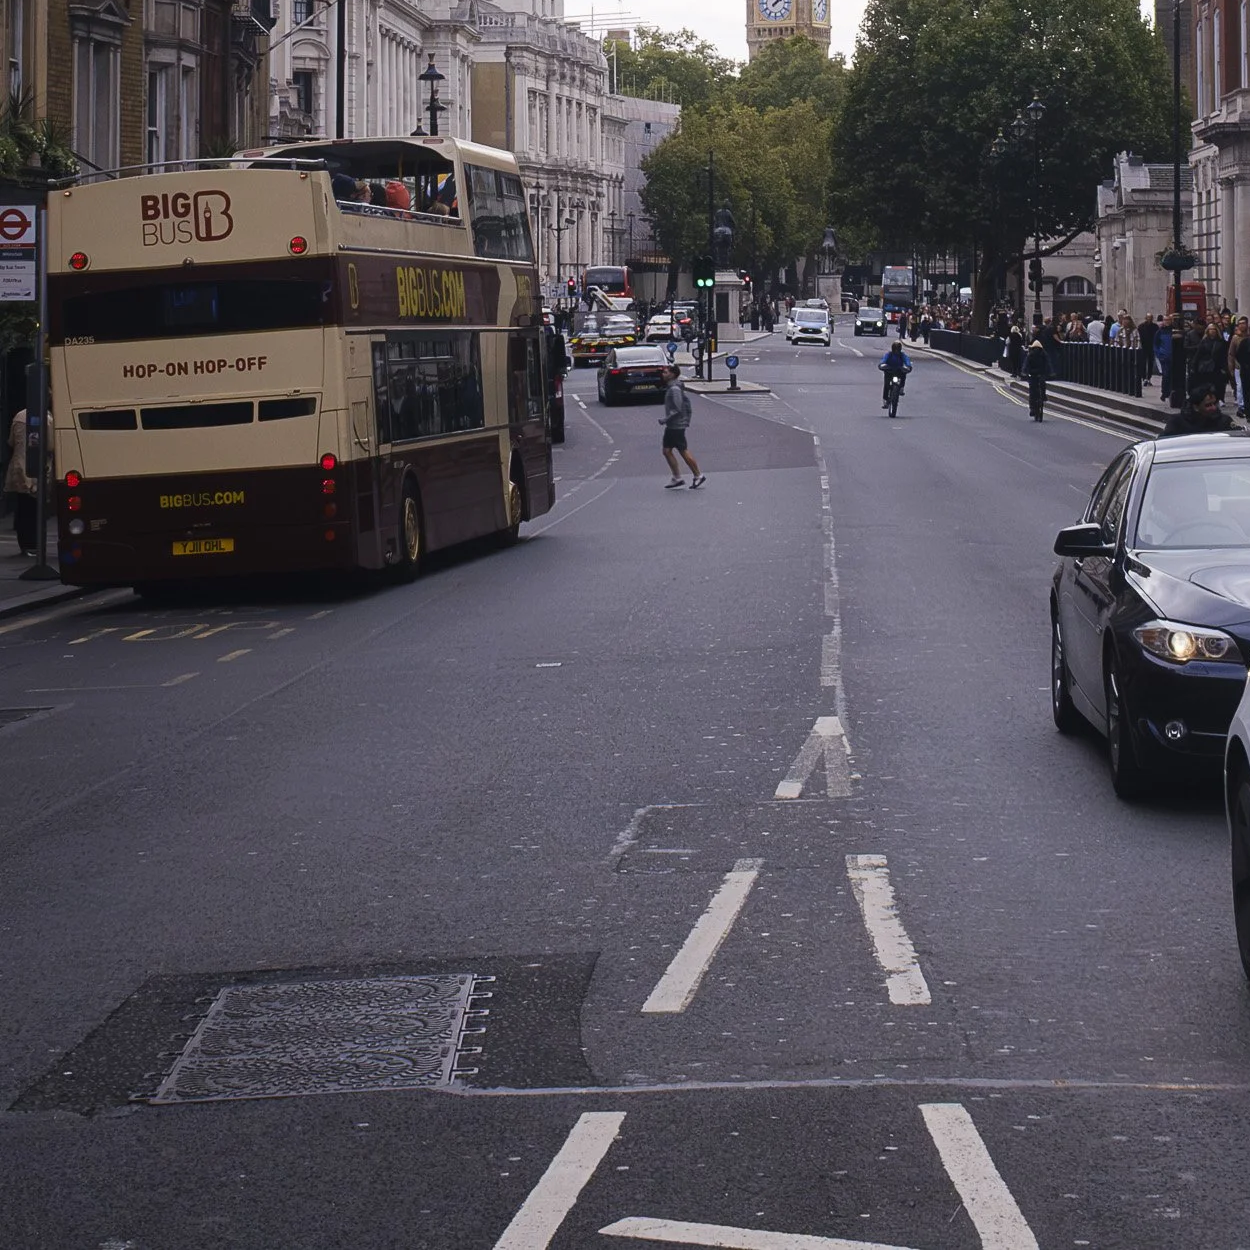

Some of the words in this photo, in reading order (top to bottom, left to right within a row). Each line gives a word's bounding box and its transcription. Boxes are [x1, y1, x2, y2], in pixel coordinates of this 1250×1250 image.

[141, 192, 192, 221] BIG
[142, 220, 193, 246] BUS
[396, 266, 467, 318] BIGBUS.COM
[64, 336, 95, 346] DA235
[123, 361, 189, 378] HOP-ON
[193, 356, 268, 375] HOP-OFF
[160, 491, 245, 508] BIGBUS.COM
